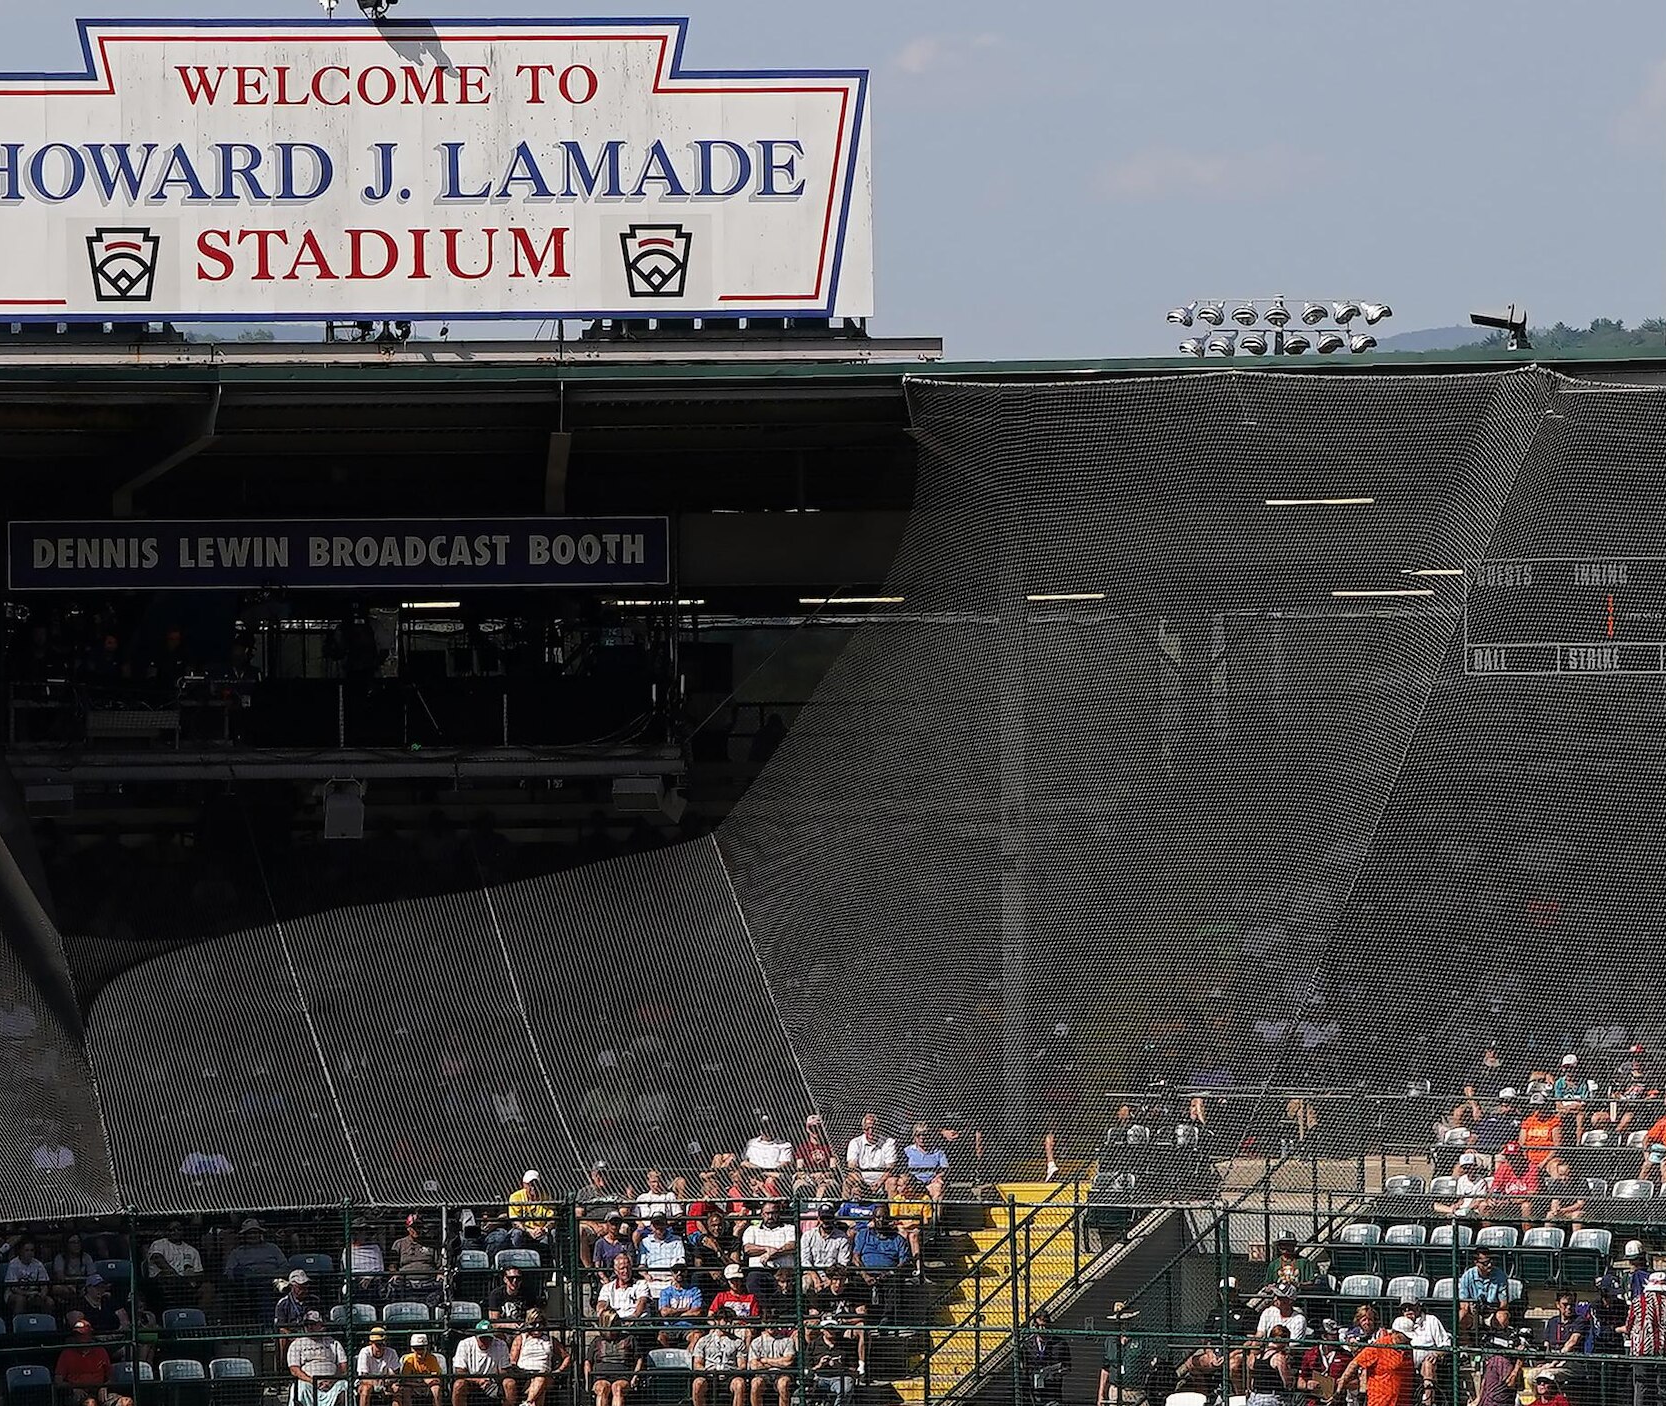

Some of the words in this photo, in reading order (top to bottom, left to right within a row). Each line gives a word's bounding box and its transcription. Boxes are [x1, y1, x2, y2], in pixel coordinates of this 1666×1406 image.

[175, 64, 492, 107] WELCOME
[526, 64, 599, 106] TO
[360, 141, 411, 206] J.
[436, 138, 807, 205] LAMADE
[196, 226, 571, 281] STADIUM
[32, 535, 159, 570] DENNIS
[177, 535, 289, 569] LEWIN
[307, 533, 512, 568] BROADCAST
[527, 531, 645, 566] BOOTH
[1573, 563, 1629, 586] INNING
[1567, 647, 1621, 670] STRIKE
